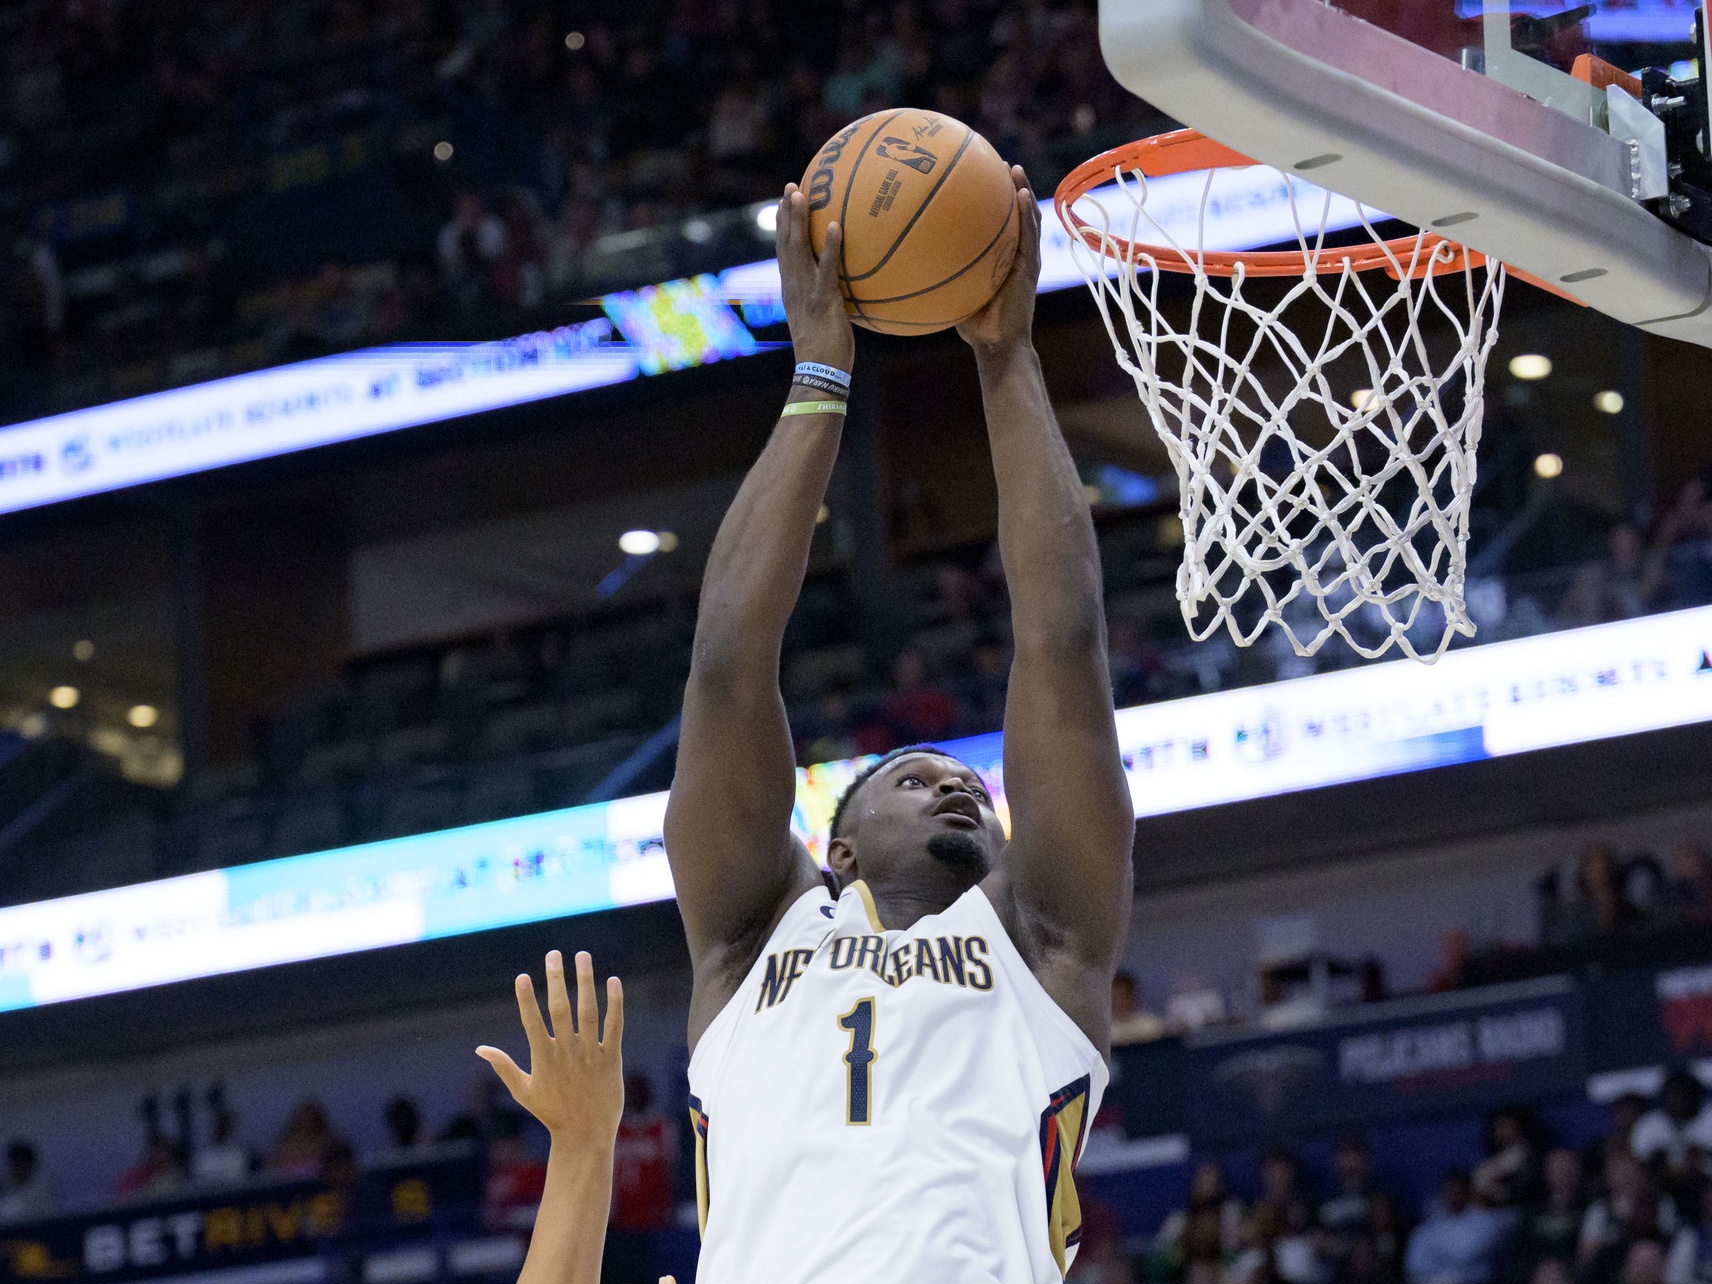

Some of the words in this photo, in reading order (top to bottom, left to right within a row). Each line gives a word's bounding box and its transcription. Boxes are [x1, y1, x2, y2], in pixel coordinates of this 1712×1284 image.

[878, 177, 894, 197] GAME
[754, 949, 814, 1015] NE
[829, 935, 995, 992] ORLEANS
[837, 996, 879, 1126] 1
